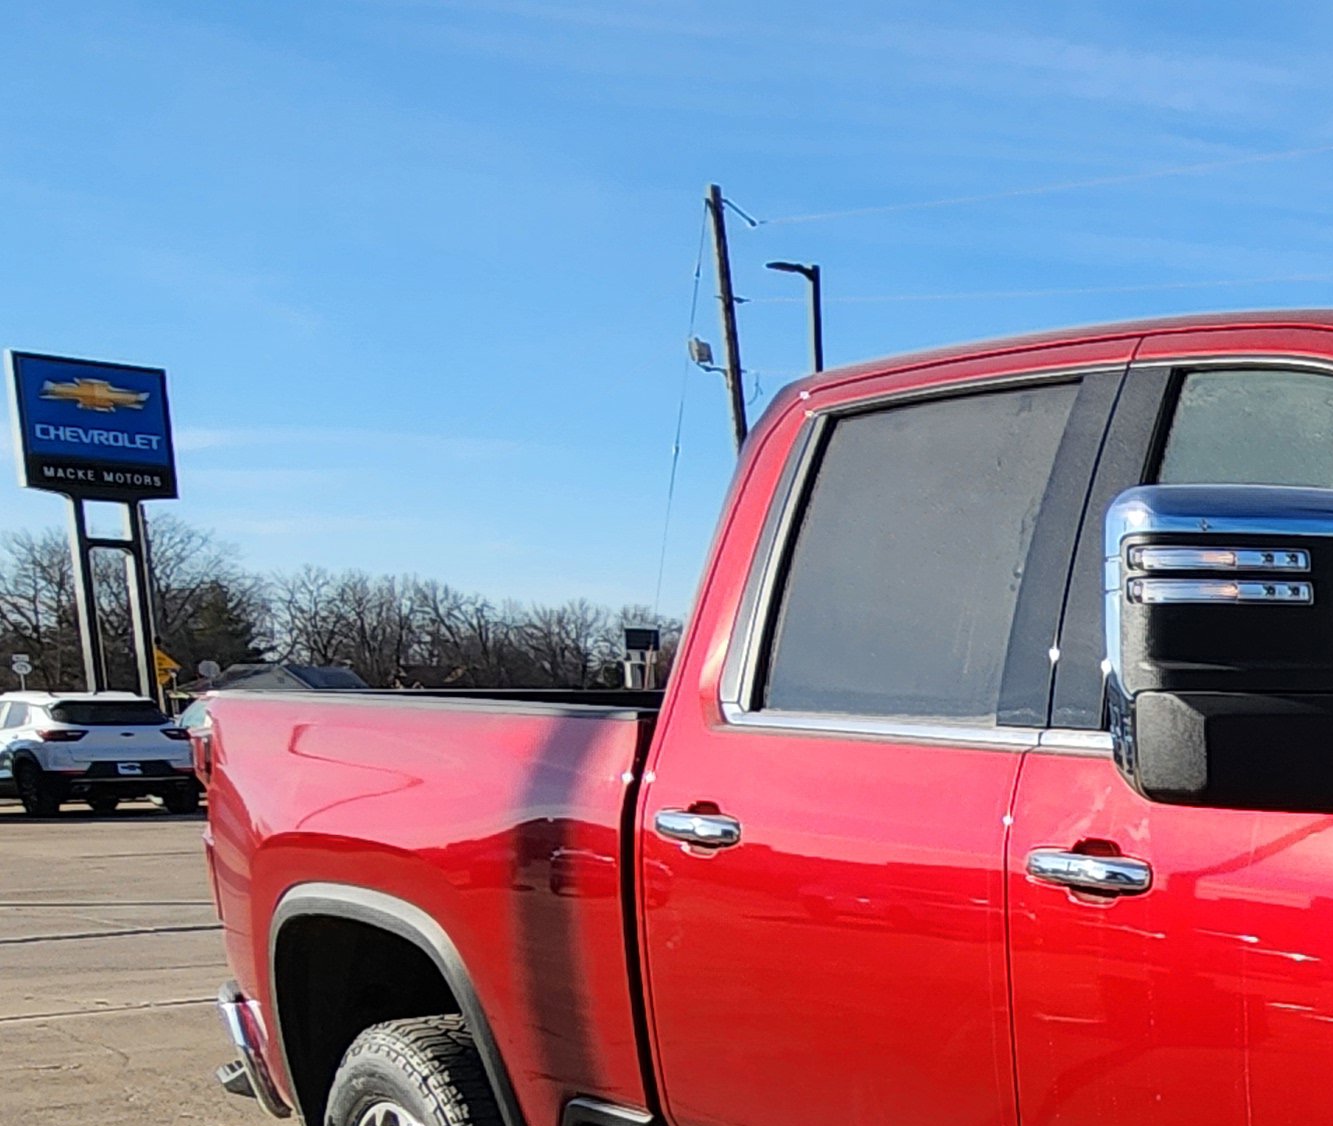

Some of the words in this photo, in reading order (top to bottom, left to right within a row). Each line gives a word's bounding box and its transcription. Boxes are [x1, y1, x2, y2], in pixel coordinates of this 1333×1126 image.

[35, 424, 161, 449] CHEVROLET
[43, 466, 95, 481] MACKE
[103, 471, 162, 487] MOTORS
